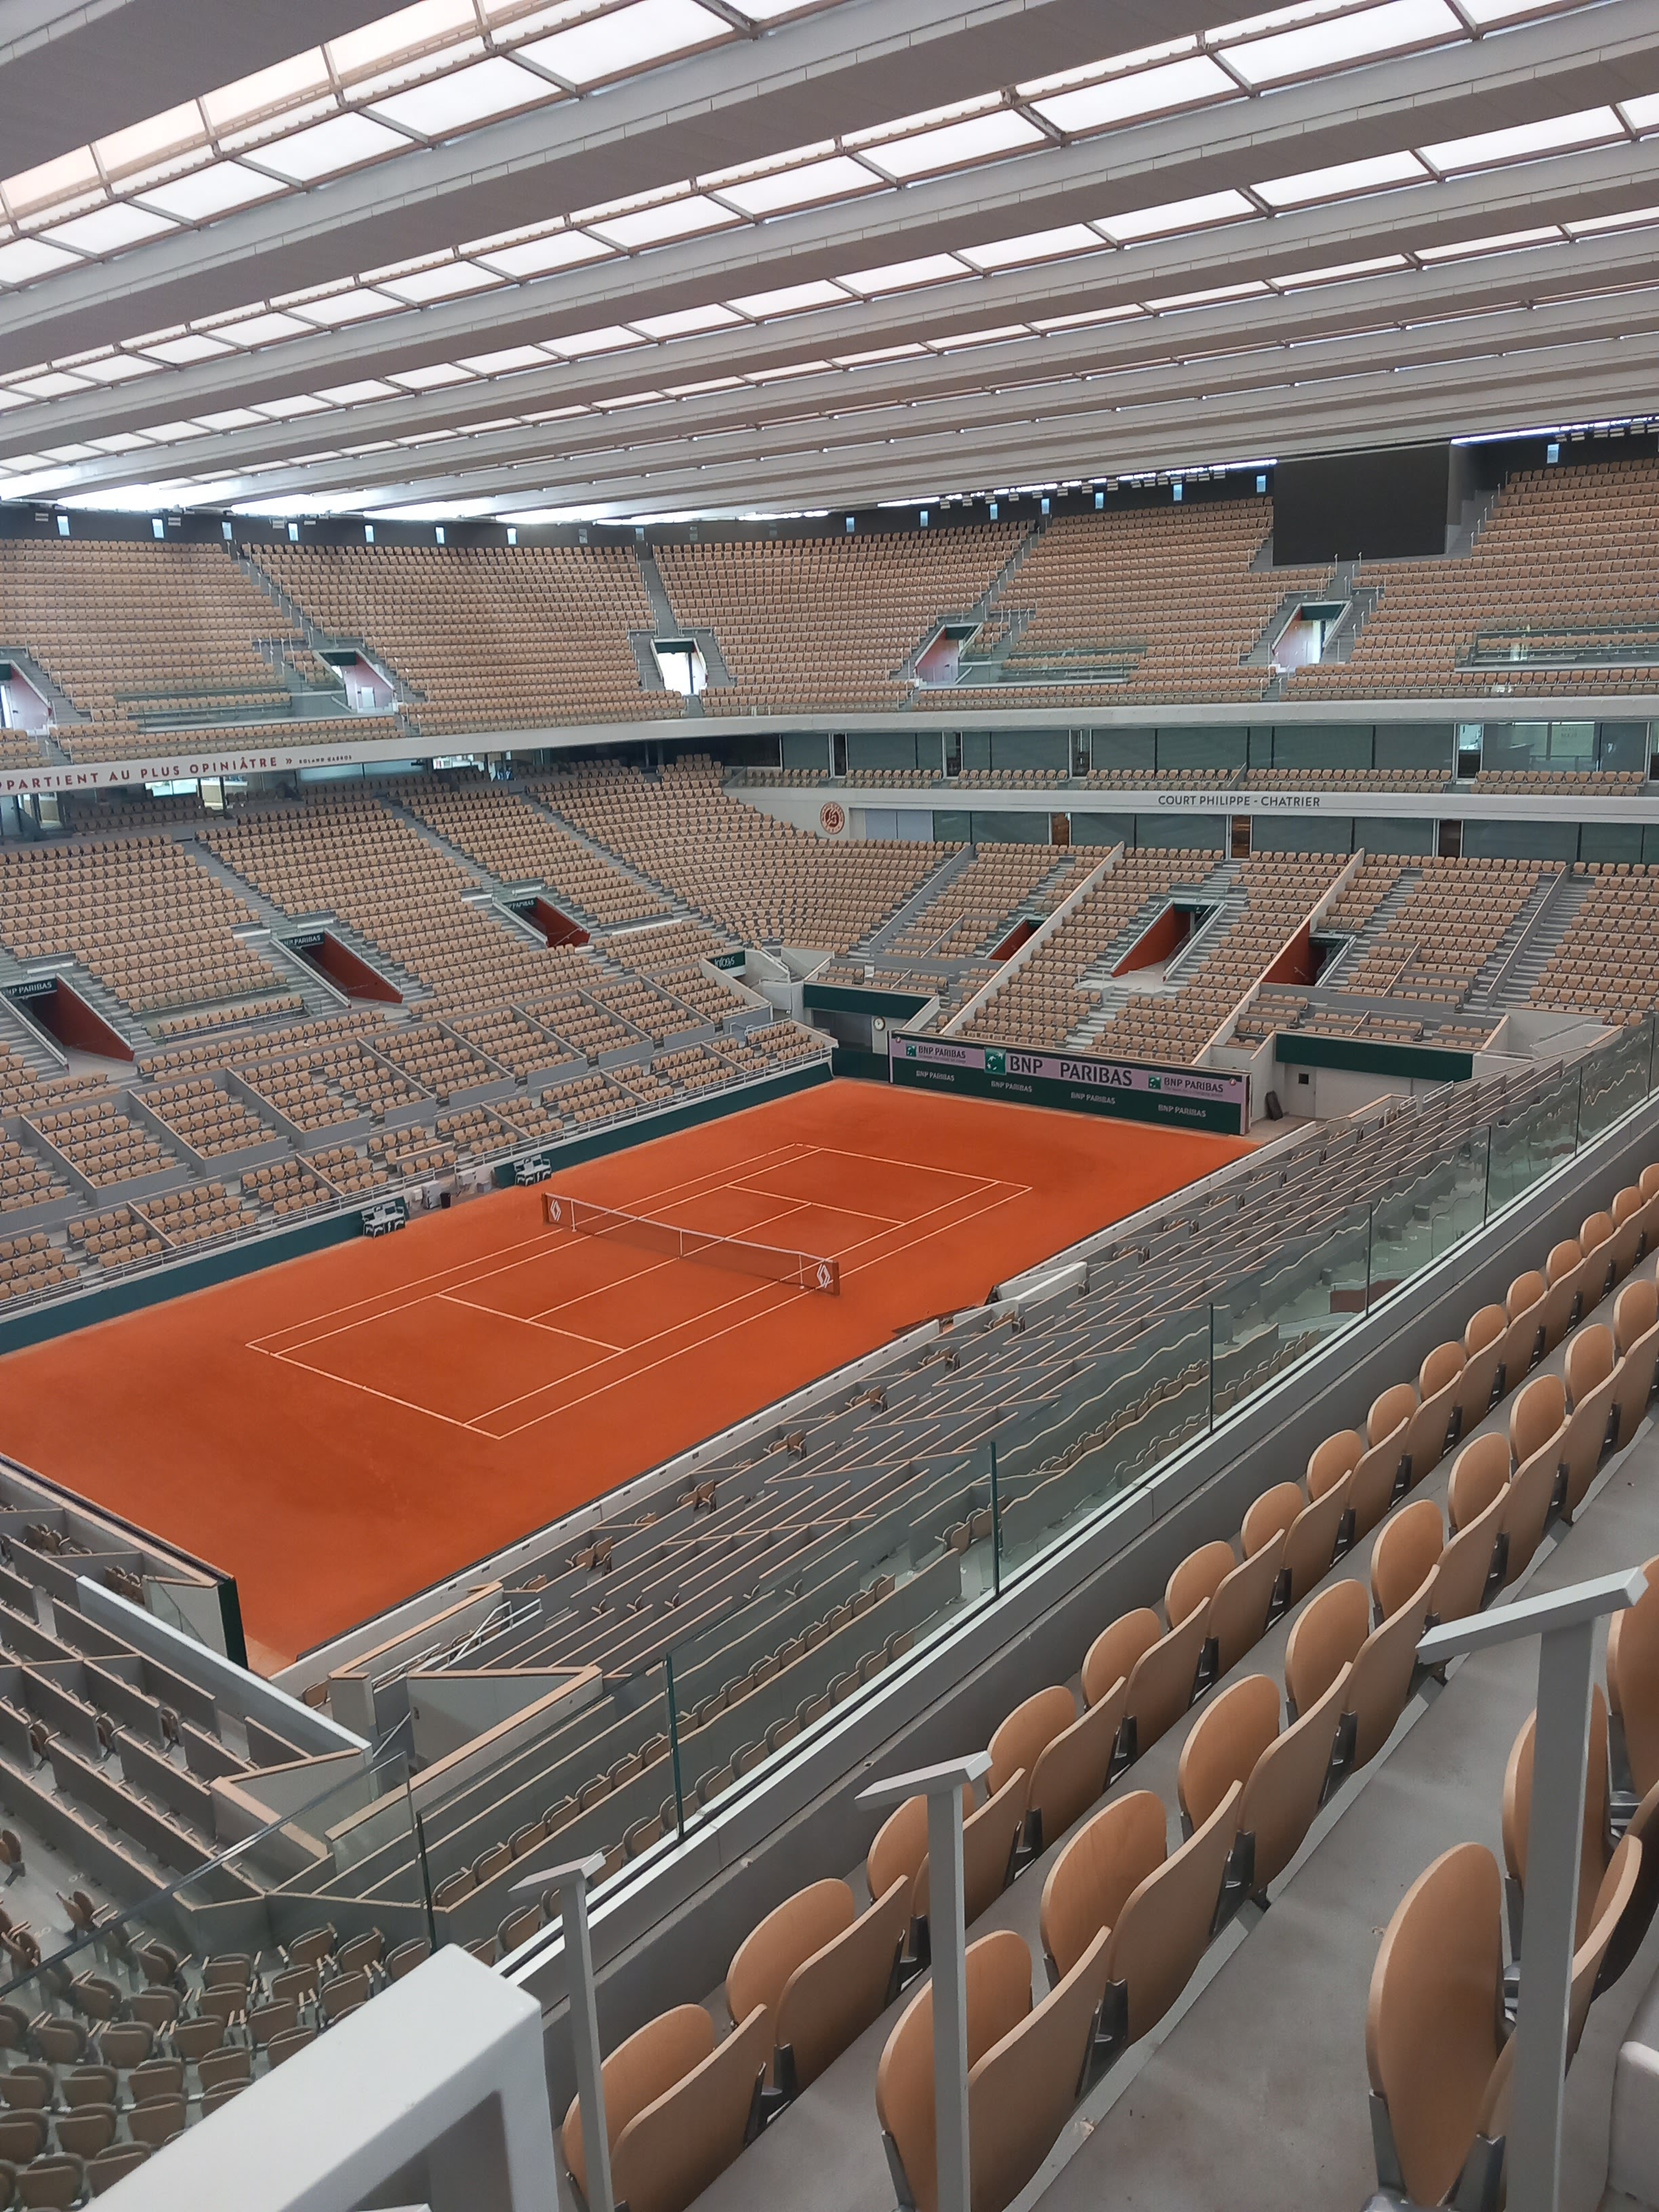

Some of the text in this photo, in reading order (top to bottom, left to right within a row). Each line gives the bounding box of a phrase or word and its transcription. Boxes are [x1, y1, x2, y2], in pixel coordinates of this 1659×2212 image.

[0, 773, 98, 791] PARTIENT
[109, 770, 130, 781] AU
[141, 766, 180, 779] PLUS
[190, 757, 276, 775] OPINIÂTRE
[1158, 796, 1196, 805] COURT
[1200, 796, 1250, 806] PHILIPPE
[1261, 796, 1320, 806] CHATRIER
[18, 981, 52, 994] PARIBAS
[918, 1046, 966, 1059] BNP PARIBAS
[1010, 1055, 1132, 1086] BNP PARIBAS
[1164, 1078, 1183, 1086] BNP
[1185, 1080, 1223, 1092] PARIBAS
[1071, 1092, 1115, 1105] BNP PARIBAS
[1158, 1104, 1206, 1118] BNP PARIBAS
